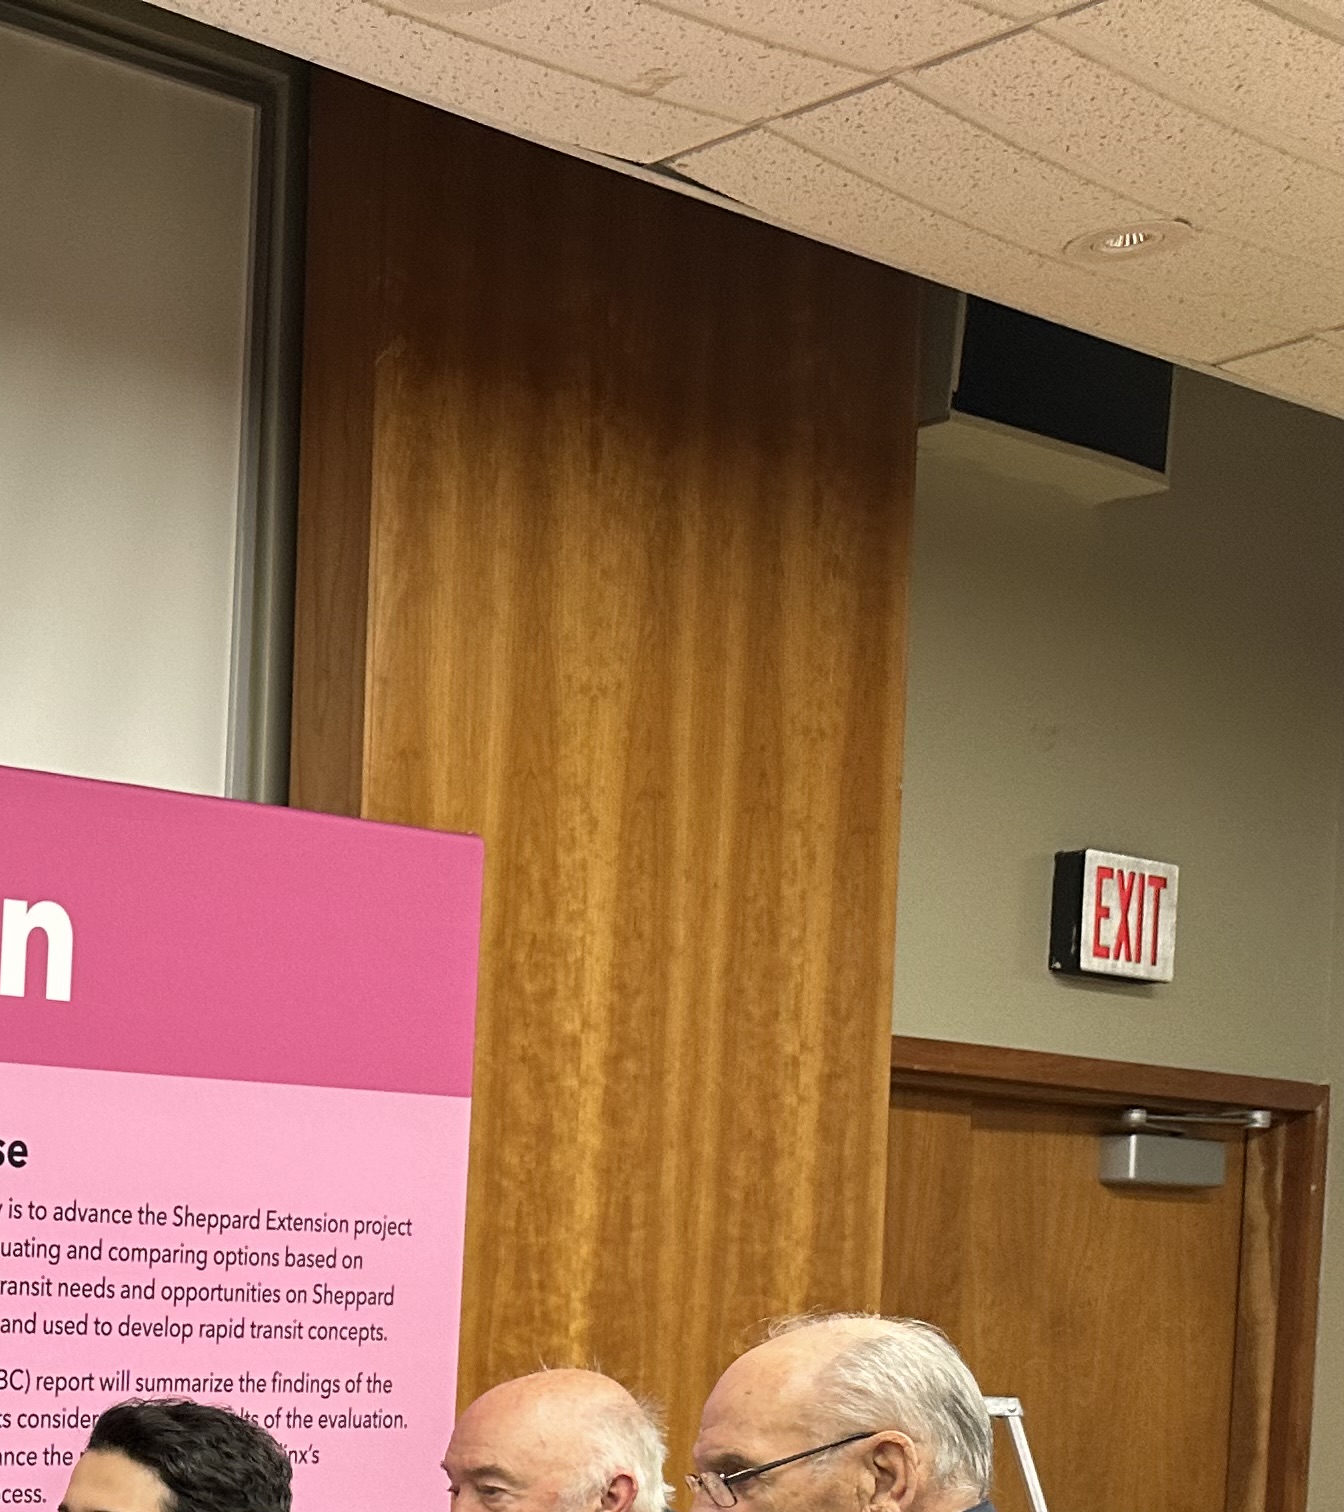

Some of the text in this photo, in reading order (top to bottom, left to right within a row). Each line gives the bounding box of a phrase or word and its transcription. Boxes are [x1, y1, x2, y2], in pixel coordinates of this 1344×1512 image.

[1093, 866, 1167, 966] EXIT
[8, 1197, 23, 1220] is
[27, 1200, 47, 1221] to
[52, 1199, 133, 1225] advance
[137, 1202, 168, 1227] the
[172, 1204, 261, 1235] Sheppard
[266, 1209, 349, 1233] Extension
[353, 1215, 413, 1242] project
[66, 1238, 103, 1261] and
[108, 1243, 208, 1271] comparing
[213, 1245, 280, 1272] options
[284, 1245, 337, 1269] based
[341, 1254, 363, 1270] on
[58, 1275, 115, 1299] needs
[120, 1277, 156, 1300] and
[161, 1282, 281, 1308] opportunities
[285, 1288, 307, 1304] on
[312, 1282, 395, 1311] Sheppard
[0, 1311, 37, 1335] and
[43, 1312, 89, 1336] used
[93, 1317, 113, 1337] to
[118, 1314, 194, 1345] develop
[199, 1316, 245, 1345] rapid
[250, 1319, 304, 1340] transit
[308, 1324, 388, 1347] concepts.
[36, 1373, 95, 1398] report
[99, 1369, 131, 1392] will
[135, 1371, 234, 1393] summarize
[238, 1370, 267, 1393] the
[271, 1370, 341, 1400] findings
[344, 1371, 364, 1394] of
[365, 1372, 393, 1394] the
[263, 1406, 283, 1429] of
[285, 1406, 313, 1429] the
[318, 1407, 408, 1429] evaluation.
[42, 1443, 74, 1467] the
